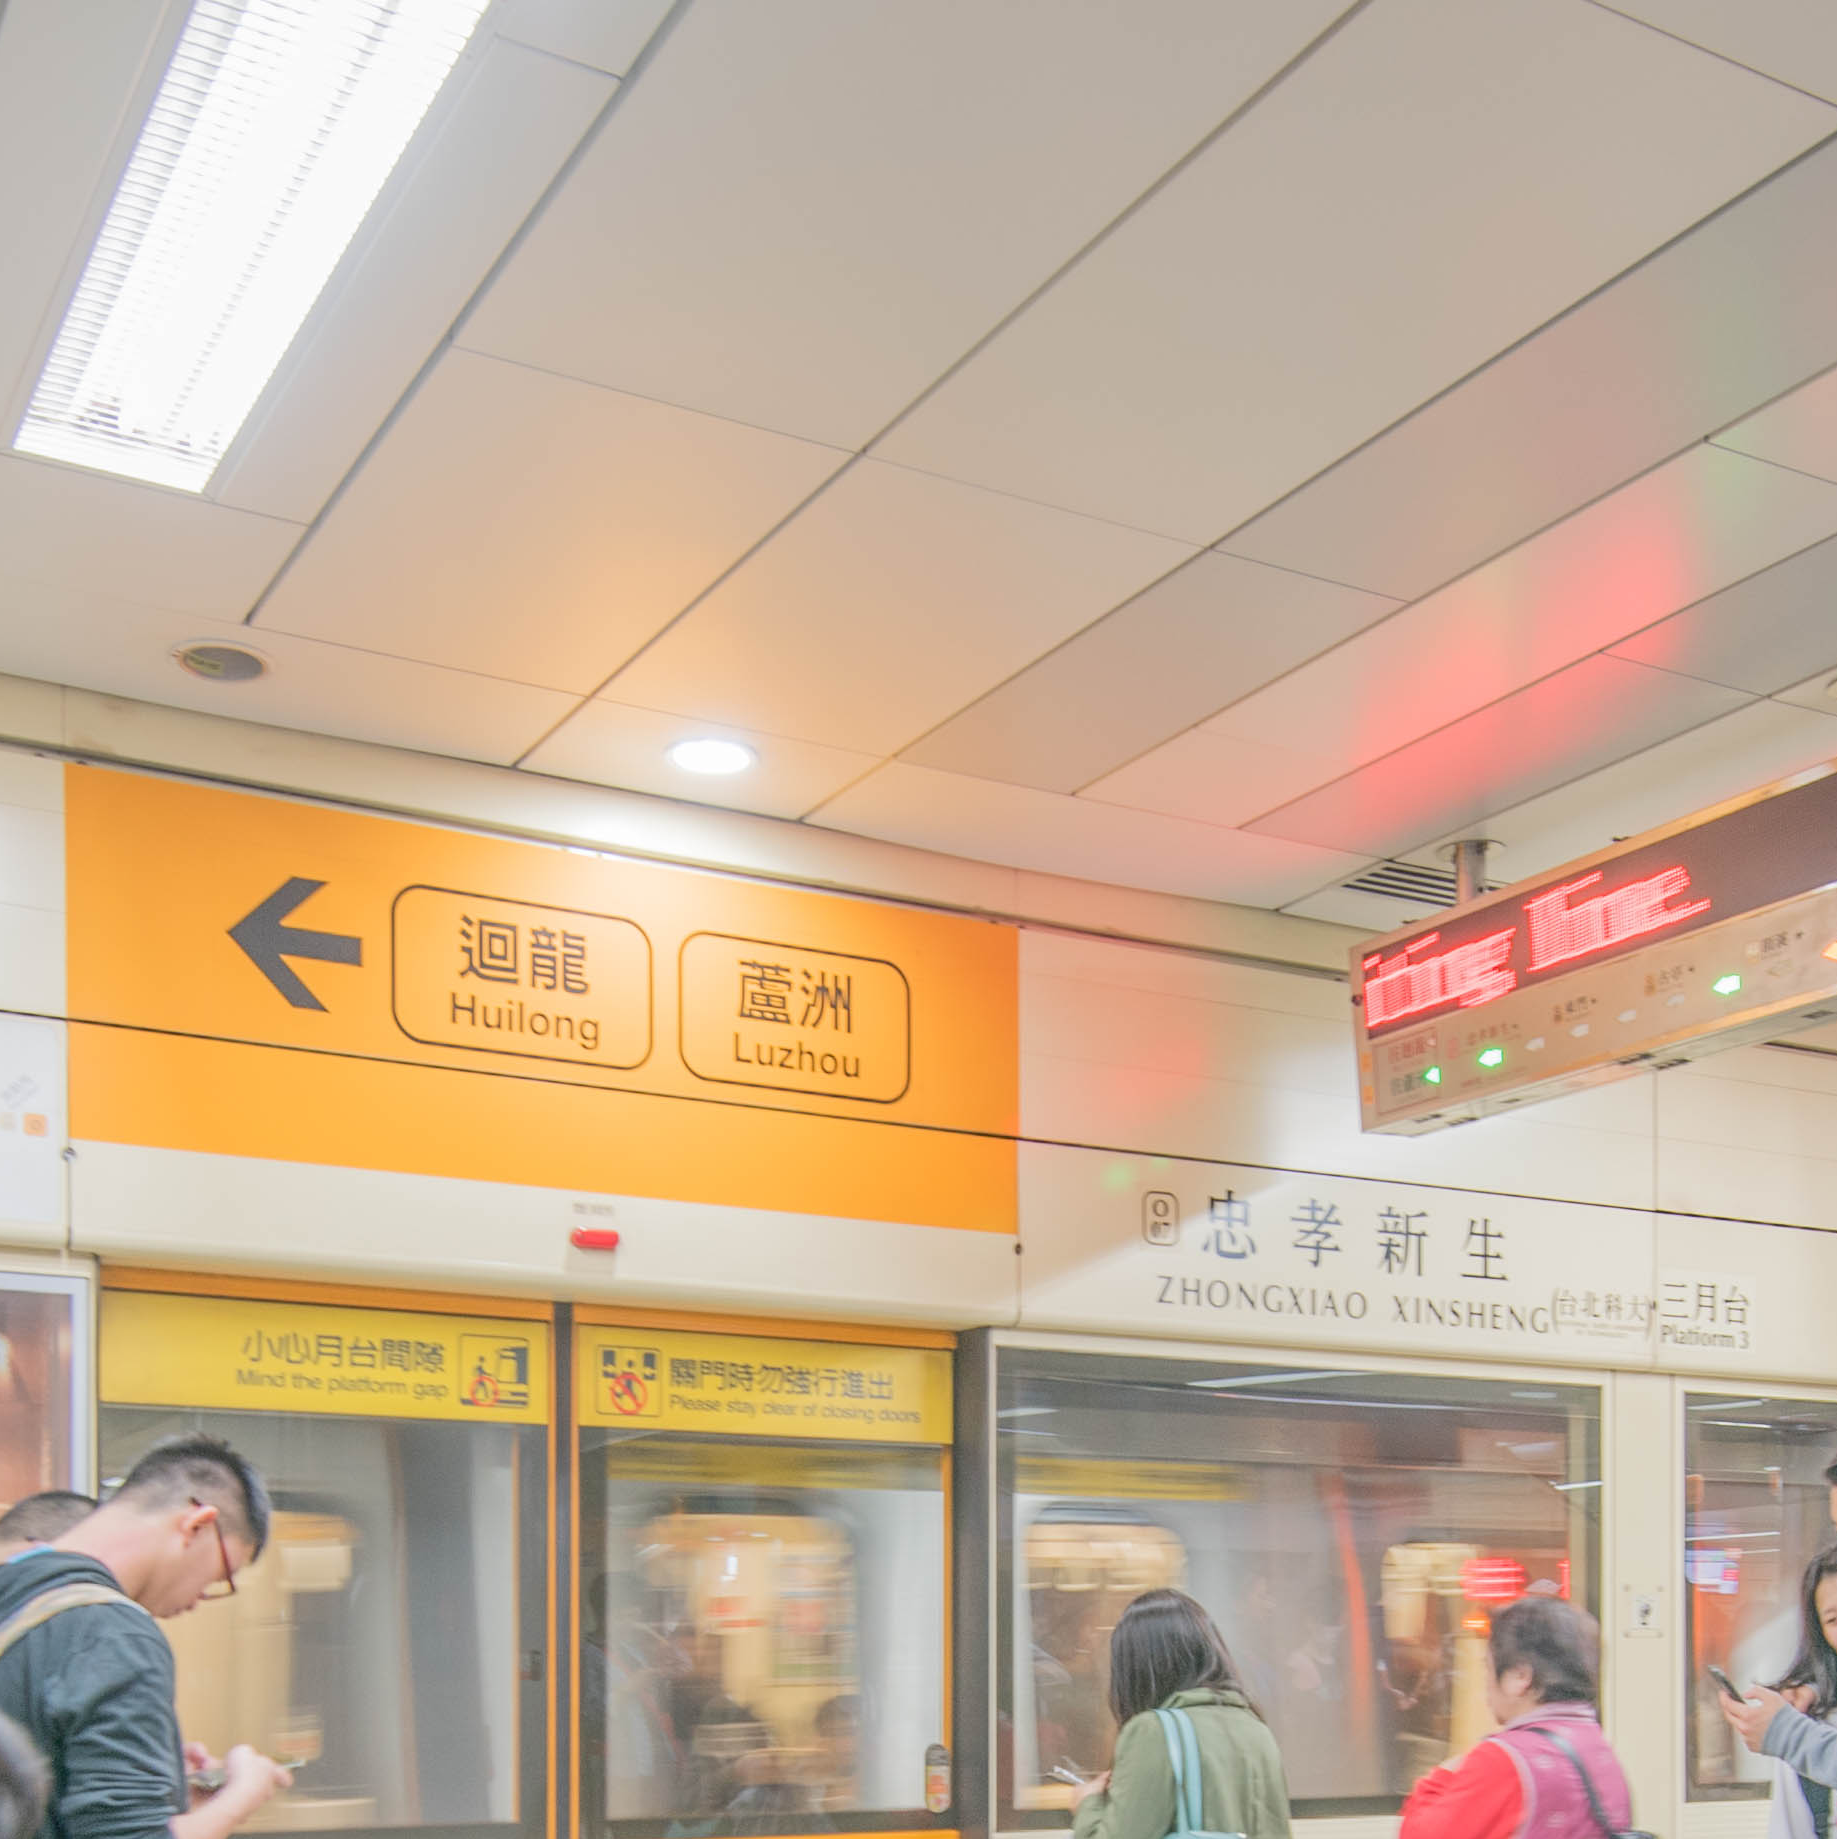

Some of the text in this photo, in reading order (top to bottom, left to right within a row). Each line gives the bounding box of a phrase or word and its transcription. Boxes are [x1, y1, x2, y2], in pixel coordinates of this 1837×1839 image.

[457, 914, 589, 995] 迴龍
[737, 960, 854, 1034] 蘆洲
[451, 993, 601, 1051] Huilong
[734, 1031, 862, 1080] Luzhou
[1202, 1189, 1509, 1283] 忠孝新生
[1156, 1274, 1550, 1335] ZHONGXIAO XINSHENG
[1661, 1281, 1750, 1324] 三月台
[242, 1330, 447, 1374] 小心月台間隙
[1661, 1324, 1750, 1350] Platform 3
[236, 1368, 449, 1400] Mind the platform gap
[670, 1358, 895, 1401] 關門時勿強行進出
[669, 1393, 922, 1424] Please stay clear of closing doors
